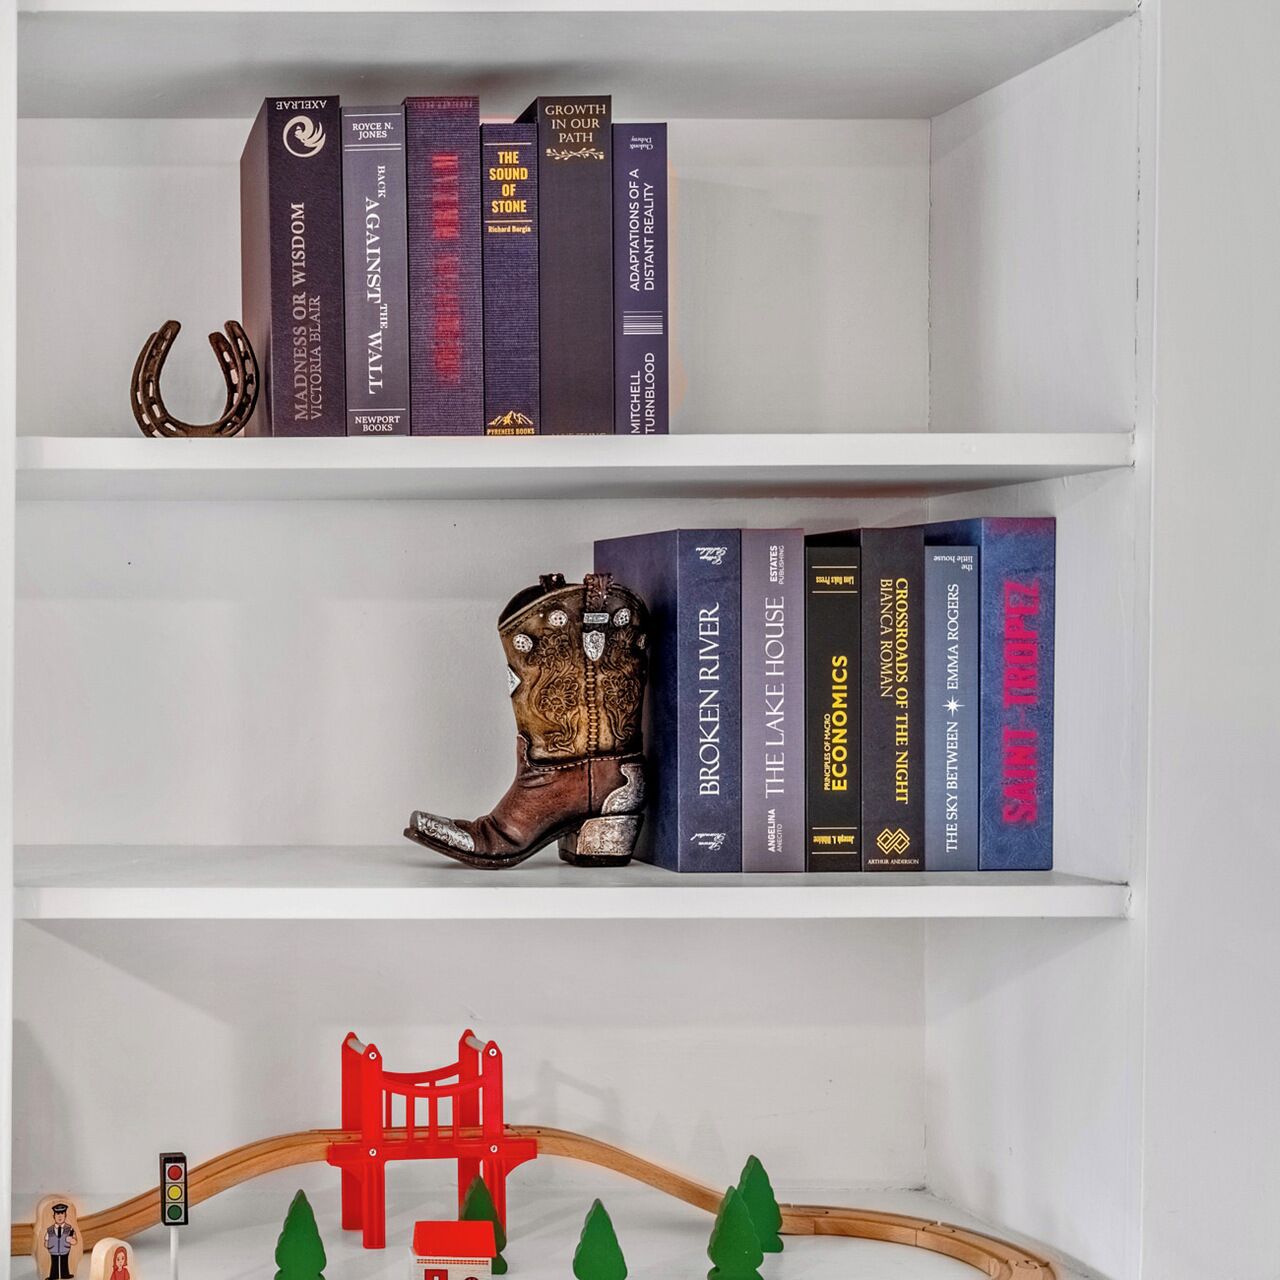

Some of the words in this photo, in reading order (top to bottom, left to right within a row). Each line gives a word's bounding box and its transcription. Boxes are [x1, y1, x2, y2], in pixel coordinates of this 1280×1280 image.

[276, 100, 328, 110] AXELRAE
[545, 104, 606, 116] GROWTH
[352, 122, 383, 132] ROYCE
[384, 122, 394, 131] N.
[358, 130, 388, 140] JONES
[551, 118, 567, 129] IN
[570, 118, 601, 129] OUR
[558, 132, 593, 143] PATH
[489, 167, 529, 181] SOUND
[497, 151, 519, 165] THE
[629, 168, 640, 179] A
[376, 165, 386, 198] BACK
[502, 184, 516, 197] OF
[629, 179, 640, 197] OF
[491, 200, 527, 214] STONE
[644, 182, 655, 236] REALITY
[291, 201, 306, 288] WISDOM
[488, 225, 511, 233] Richard
[629, 198, 641, 291] ADAPTATIONS
[366, 197, 382, 304] AGAINST
[644, 237, 655, 291] DISTANT
[292, 291, 306, 320] OR
[308, 295, 321, 342] BLAIR
[379, 303, 388, 329] THE
[294, 325, 308, 420] MADNESS
[368, 331, 384, 395] WALL
[309, 345, 322, 420] VICTORIA
[644, 352, 655, 434] TURNBLOOD
[630, 370, 641, 434] MITCHELL
[355, 415, 400, 425] NEWPORT
[363, 423, 393, 432] BOOKS
[770, 545, 778, 582] ESTATES
[933, 554, 955, 563] house
[956, 554, 973, 563] little
[961, 562, 973, 571] the
[815, 576, 830, 585] Press
[879, 578, 893, 636] BIANCA
[947, 583, 959, 641] ROGERS
[699, 602, 720, 681] RIVER
[764, 596, 785, 676] HOUSE
[895, 577, 909, 683] CROSSROADS
[879, 641, 893, 698] ROMAN
[947, 643, 959, 691] EMMA
[895, 686, 909, 708] OF
[765, 683, 785, 750] LAKE
[832, 655, 847, 791] ECONOMICS
[895, 712, 909, 744] THE
[699, 688, 720, 796] BROKEN
[824, 740, 831, 751] OF
[946, 721, 958, 790] BETWEEN
[765, 752, 785, 799] THE
[895, 749, 909, 804] NIGHT
[946, 791, 958, 822] SKY
[768, 808, 776, 852] ANGELINA
[946, 823, 958, 853] THE
